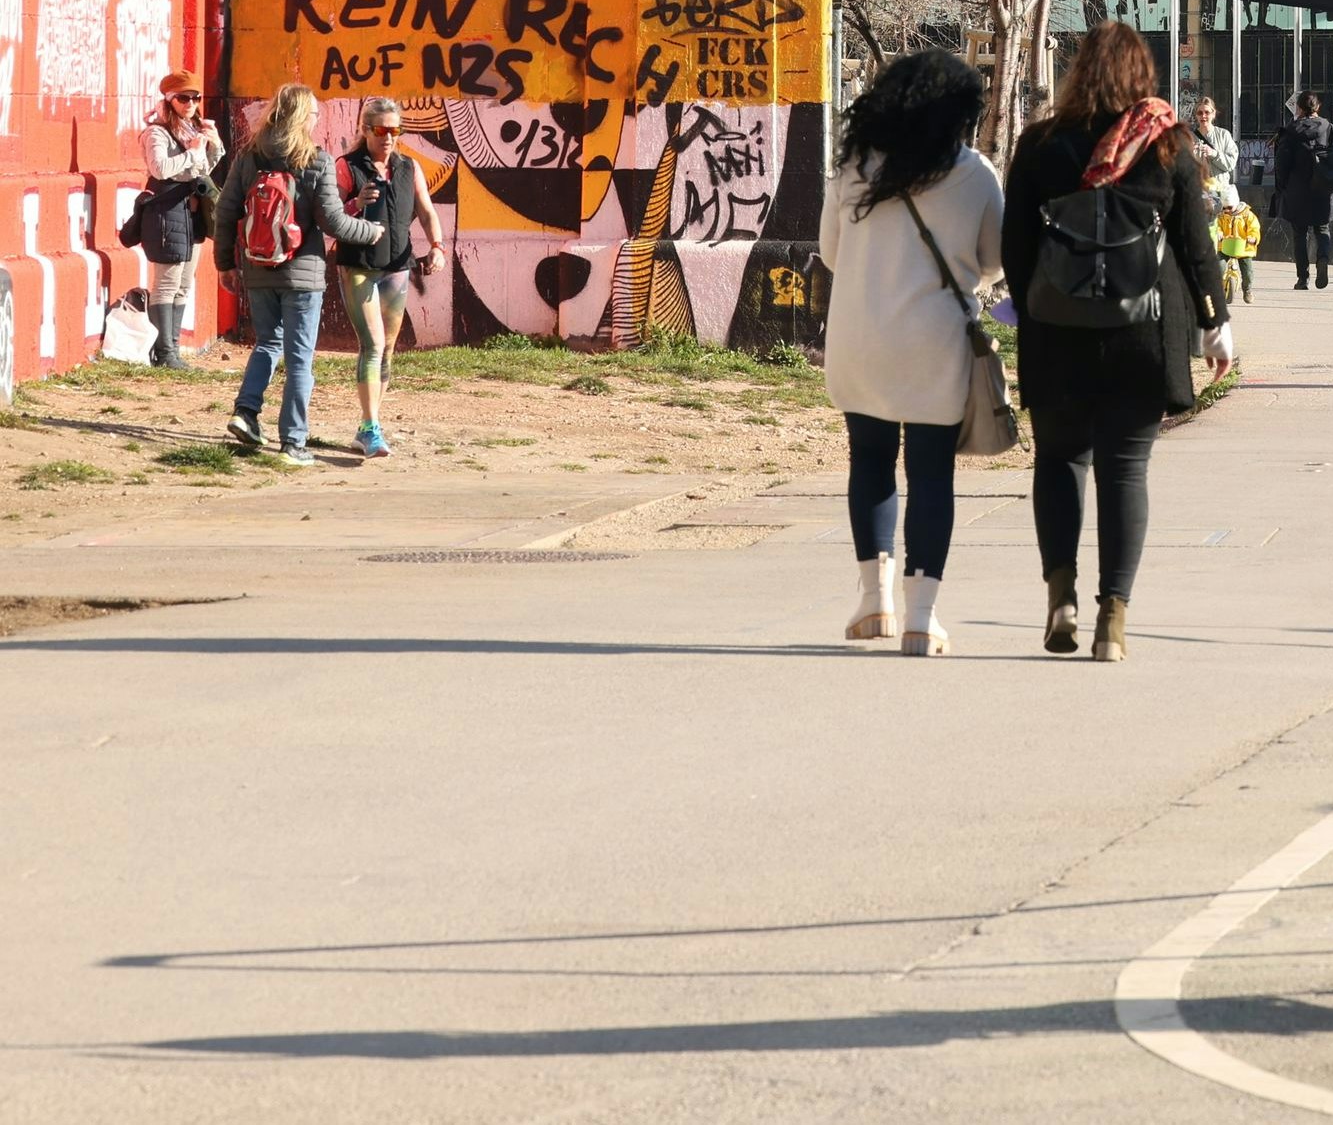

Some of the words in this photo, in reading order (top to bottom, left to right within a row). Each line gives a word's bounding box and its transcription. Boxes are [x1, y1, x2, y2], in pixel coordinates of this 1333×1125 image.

[696, 37, 770, 66] FCK
[320, 43, 406, 92] AUF
[696, 69, 769, 98] CRS
